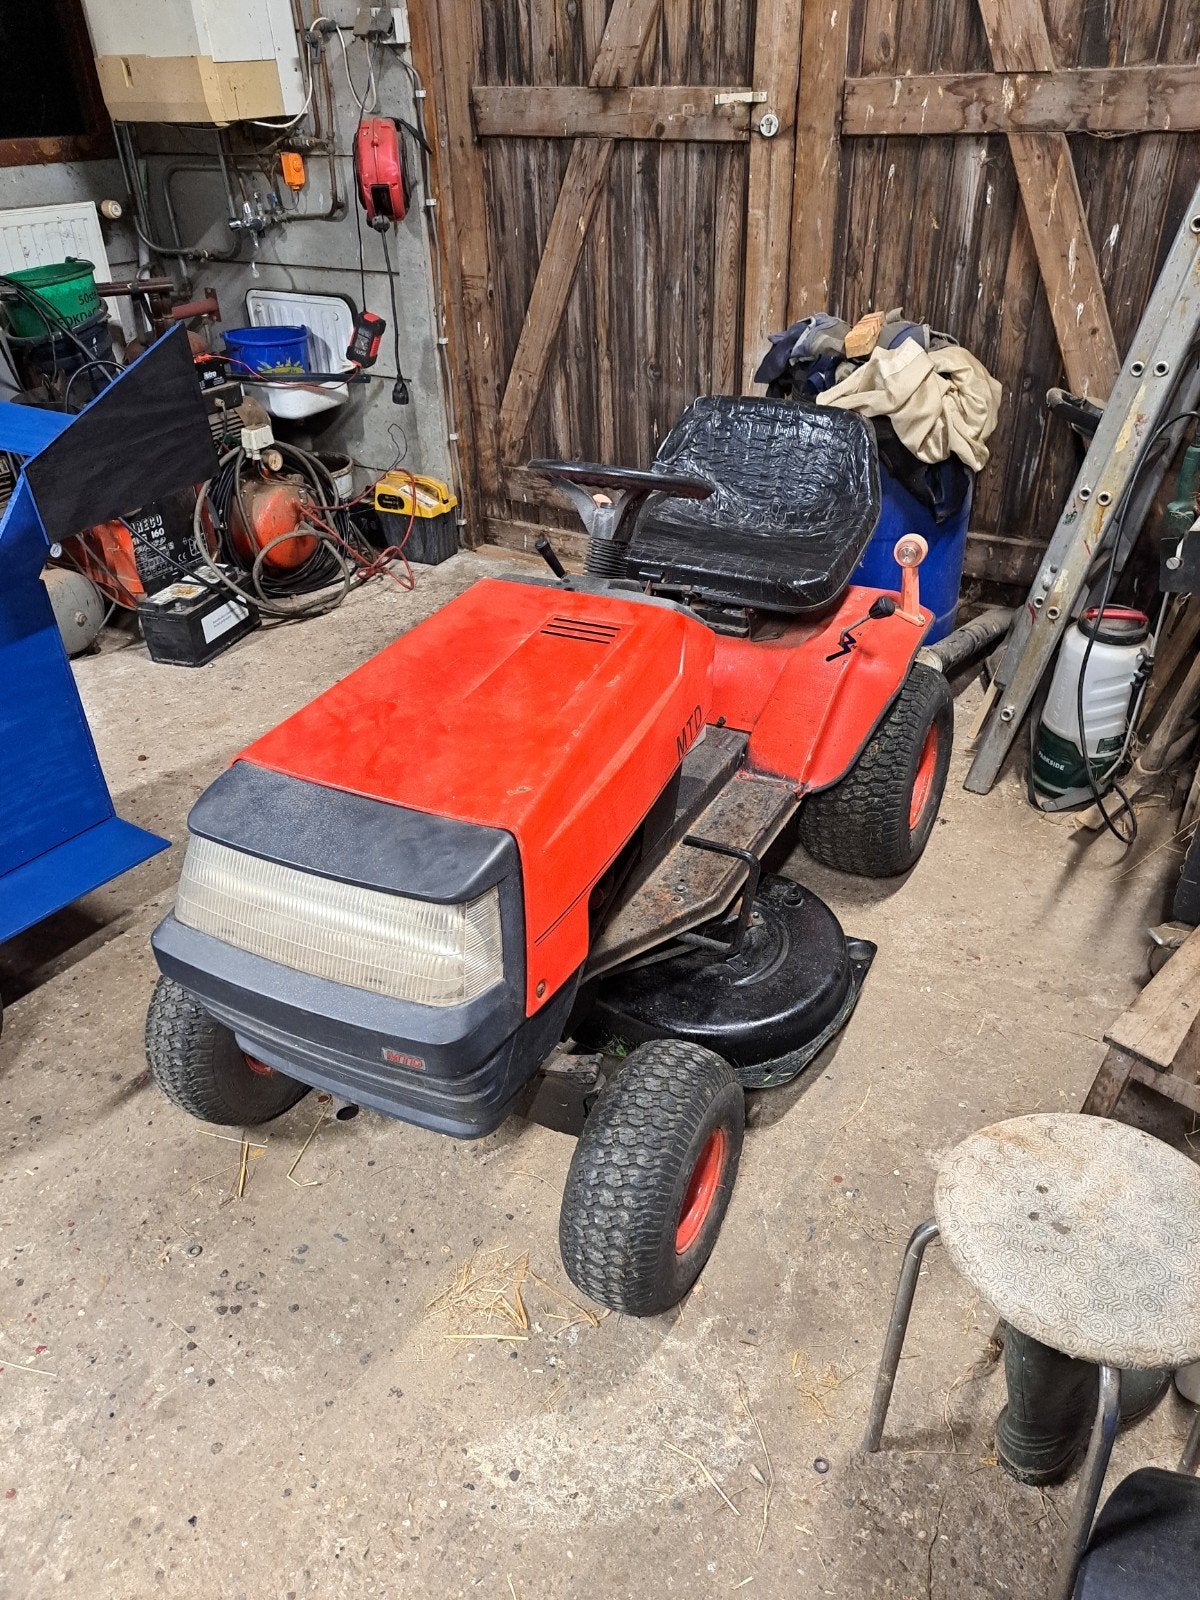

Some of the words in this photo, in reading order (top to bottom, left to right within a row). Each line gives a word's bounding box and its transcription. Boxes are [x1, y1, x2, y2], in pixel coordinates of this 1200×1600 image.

[151, 527, 165, 539] 160
[676, 704, 702, 761] MTD
[1038, 750, 1065, 771] PARKSIDE
